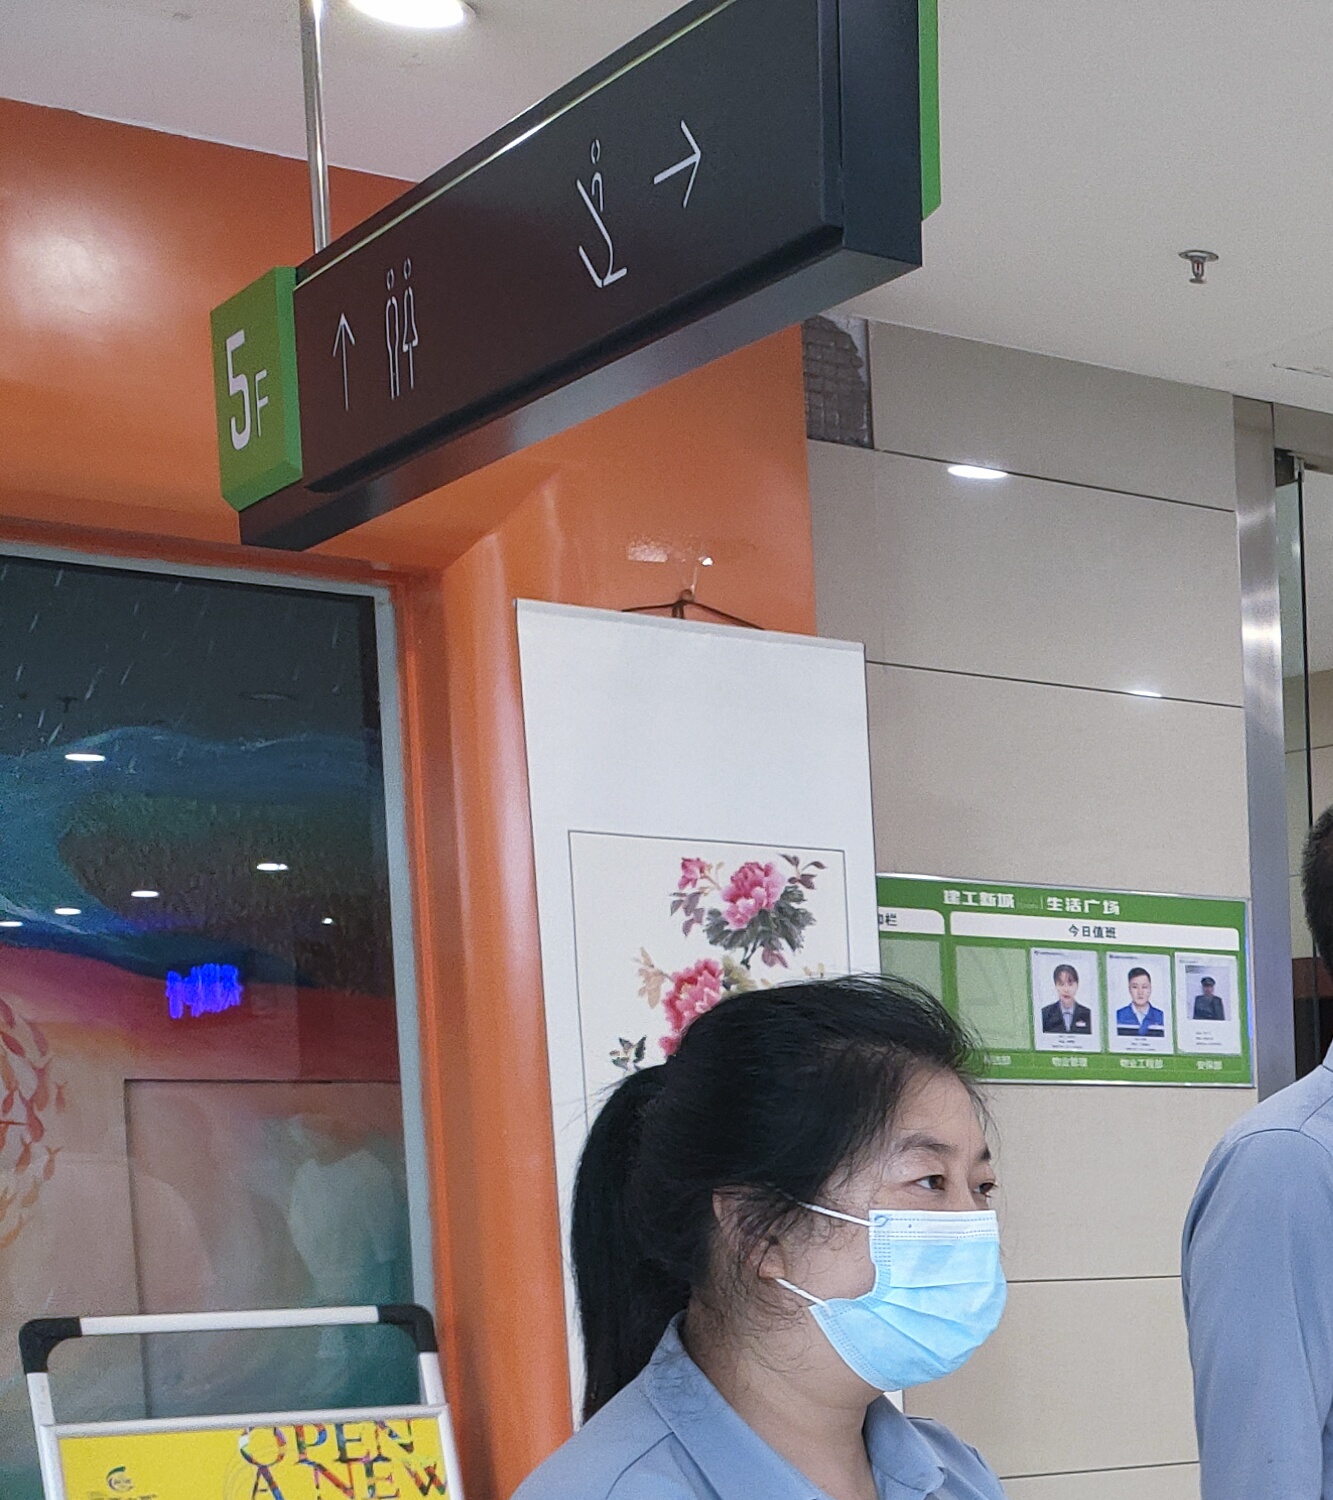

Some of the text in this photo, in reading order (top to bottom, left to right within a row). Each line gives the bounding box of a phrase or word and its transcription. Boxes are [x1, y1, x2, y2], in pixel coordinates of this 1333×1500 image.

[225, 329, 269, 451] 5F
[1046, 896, 1120, 915] 生活广场
[1068, 924, 1117, 939] 今日值班
[238, 1419, 415, 1468] OPEN
